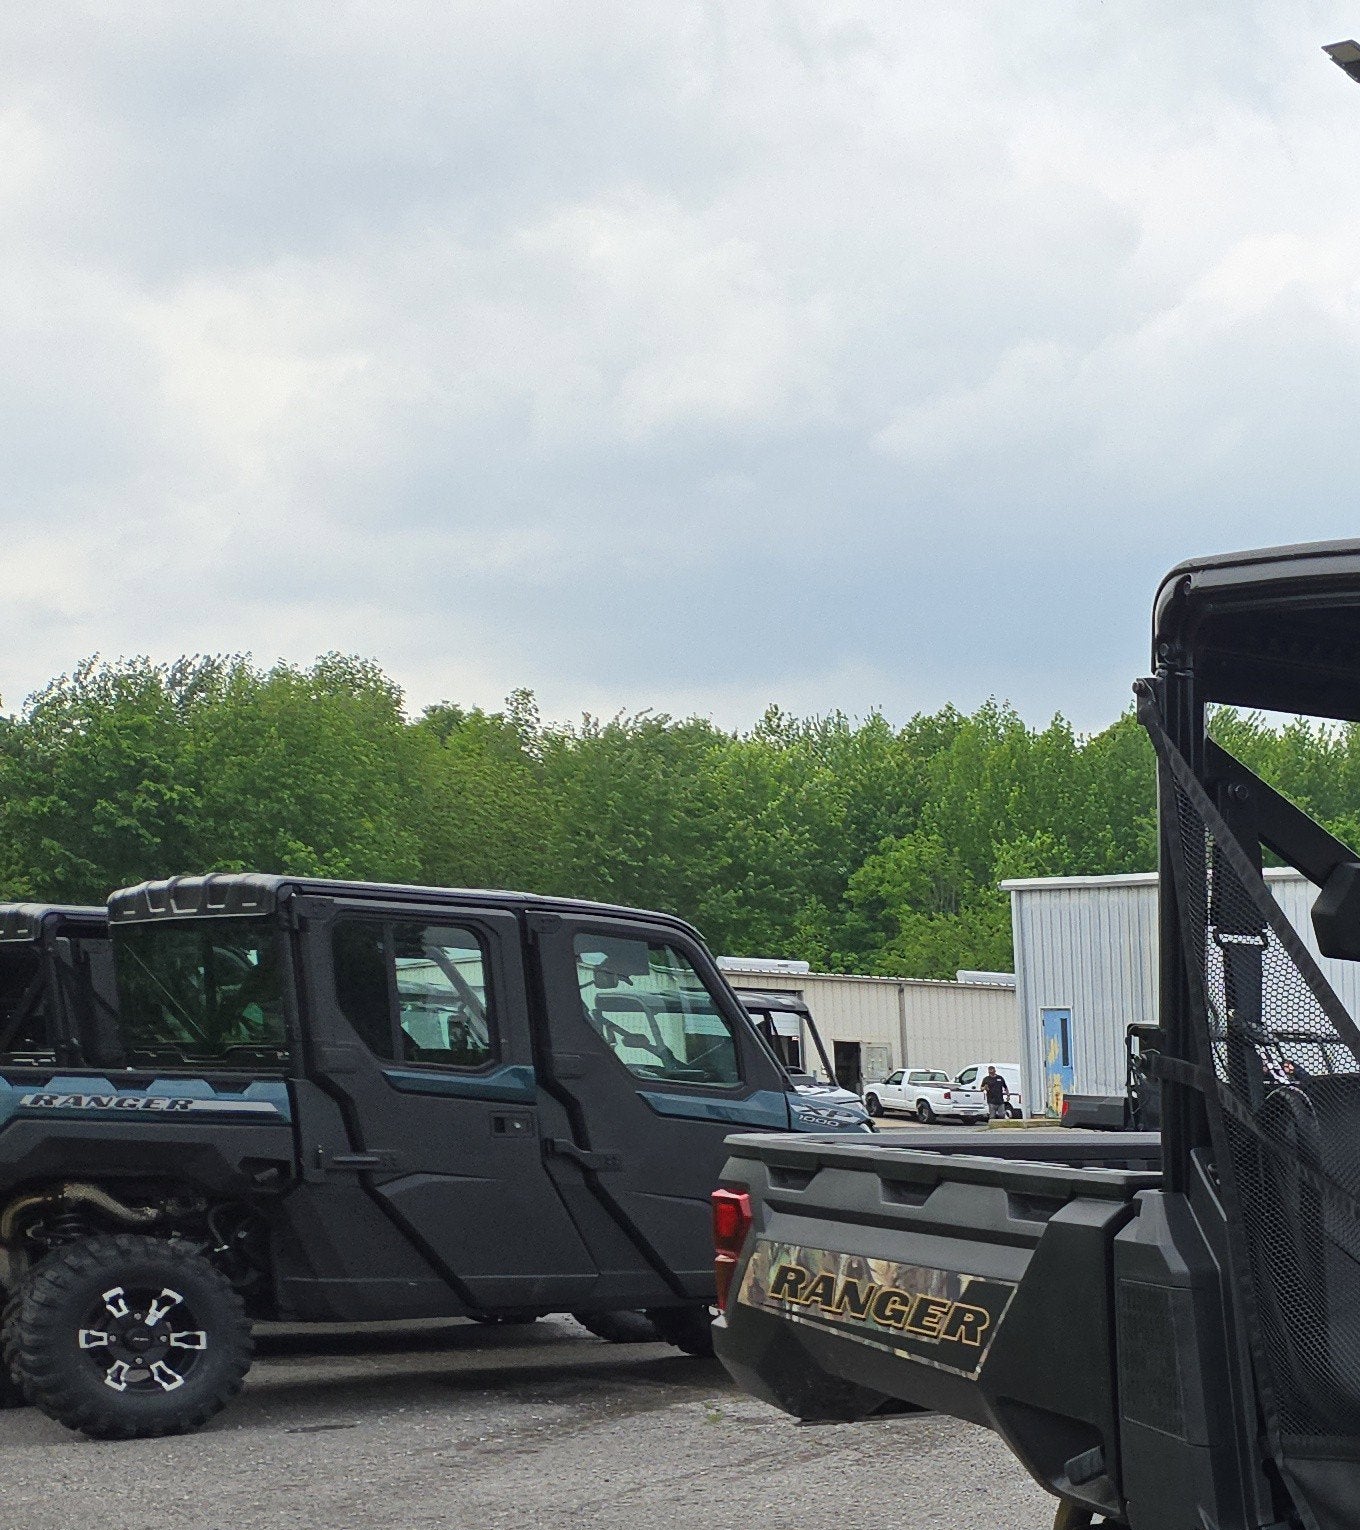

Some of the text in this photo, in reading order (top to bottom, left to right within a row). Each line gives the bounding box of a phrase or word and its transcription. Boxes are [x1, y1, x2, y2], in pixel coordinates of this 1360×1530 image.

[28, 1094, 195, 1110] RANGER
[798, 1115, 840, 1127] 1000
[768, 1263, 991, 1347] RANGER
